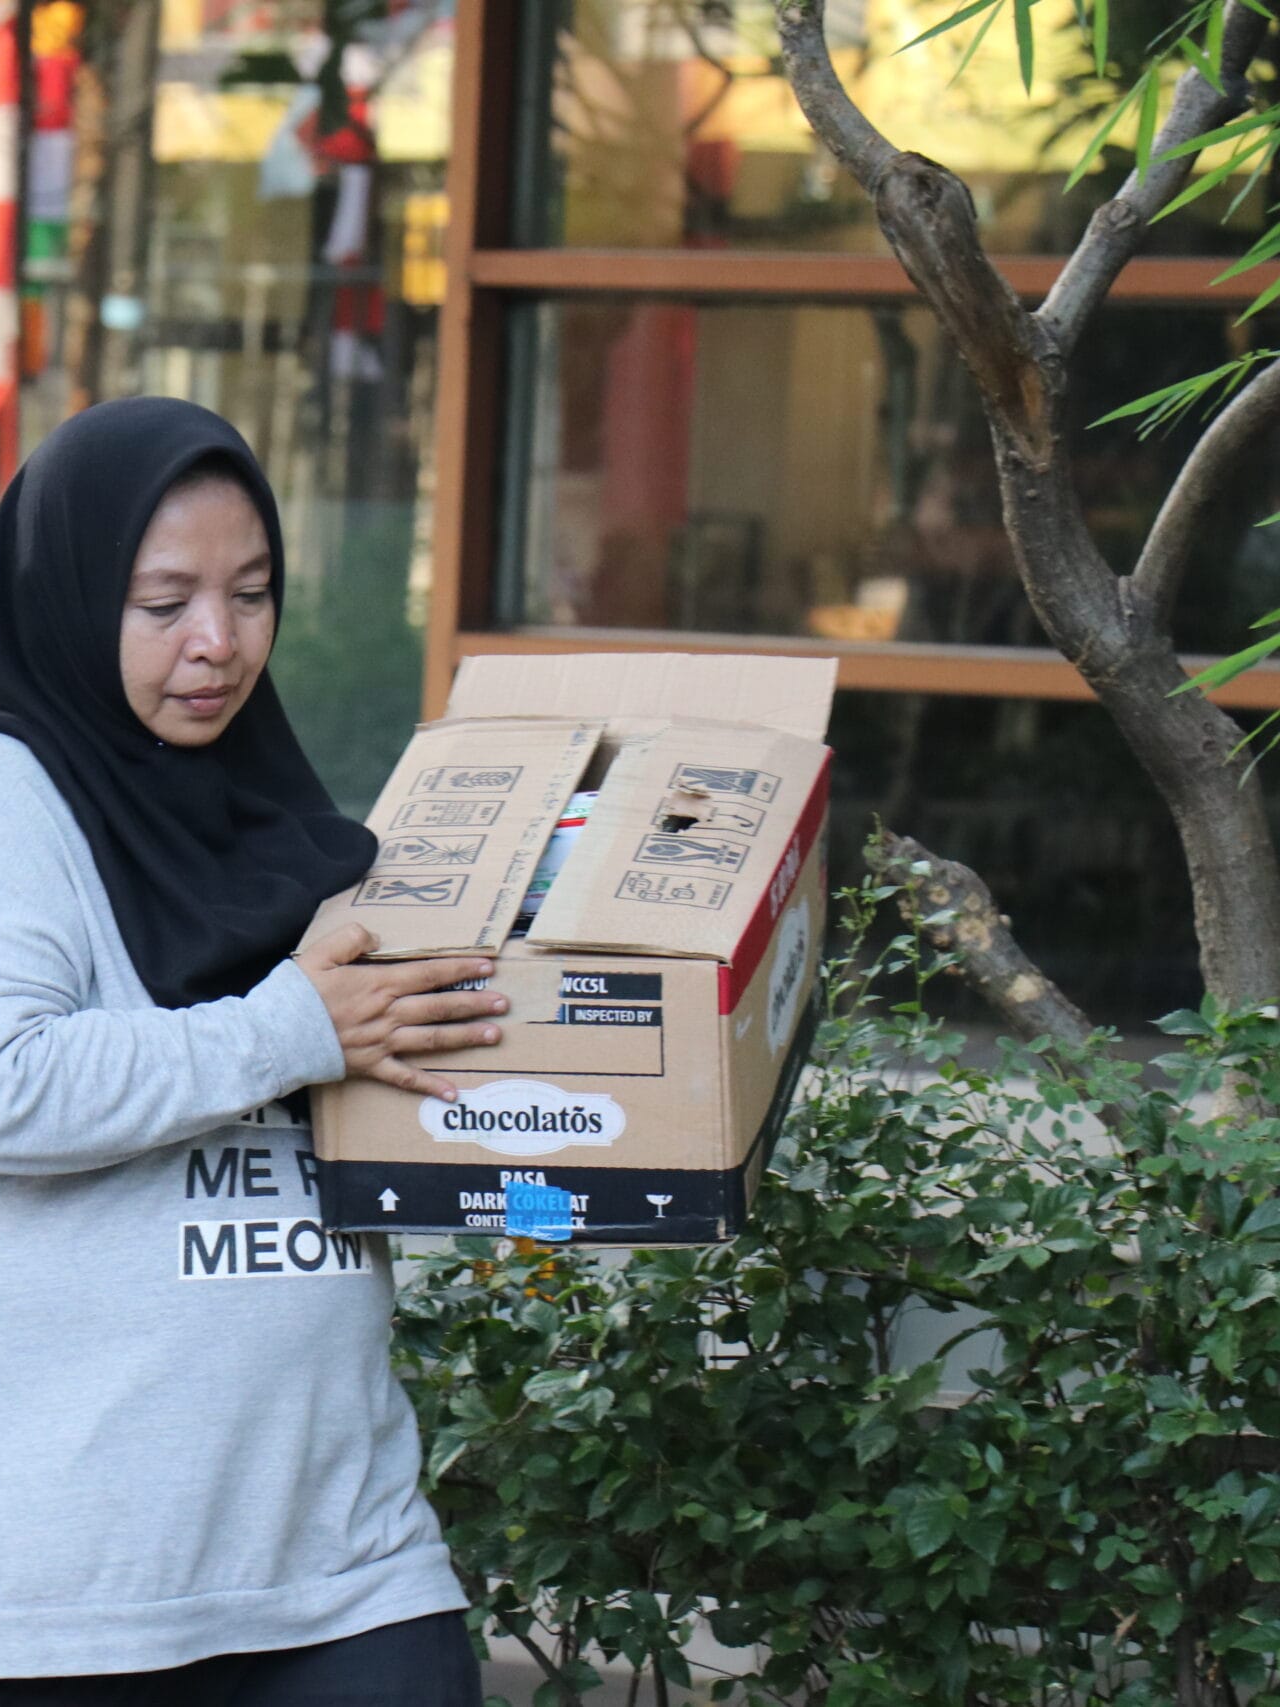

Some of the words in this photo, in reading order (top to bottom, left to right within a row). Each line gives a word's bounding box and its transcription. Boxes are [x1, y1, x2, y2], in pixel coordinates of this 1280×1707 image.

[575, 1009, 635, 1022] INSPECTED
[637, 1011, 653, 1023] BY
[443, 1104, 602, 1134] chocolatõs
[185, 1147, 279, 1199] ME
[459, 1191, 508, 1210] DARK
[512, 1193, 589, 1212] COKELAT
